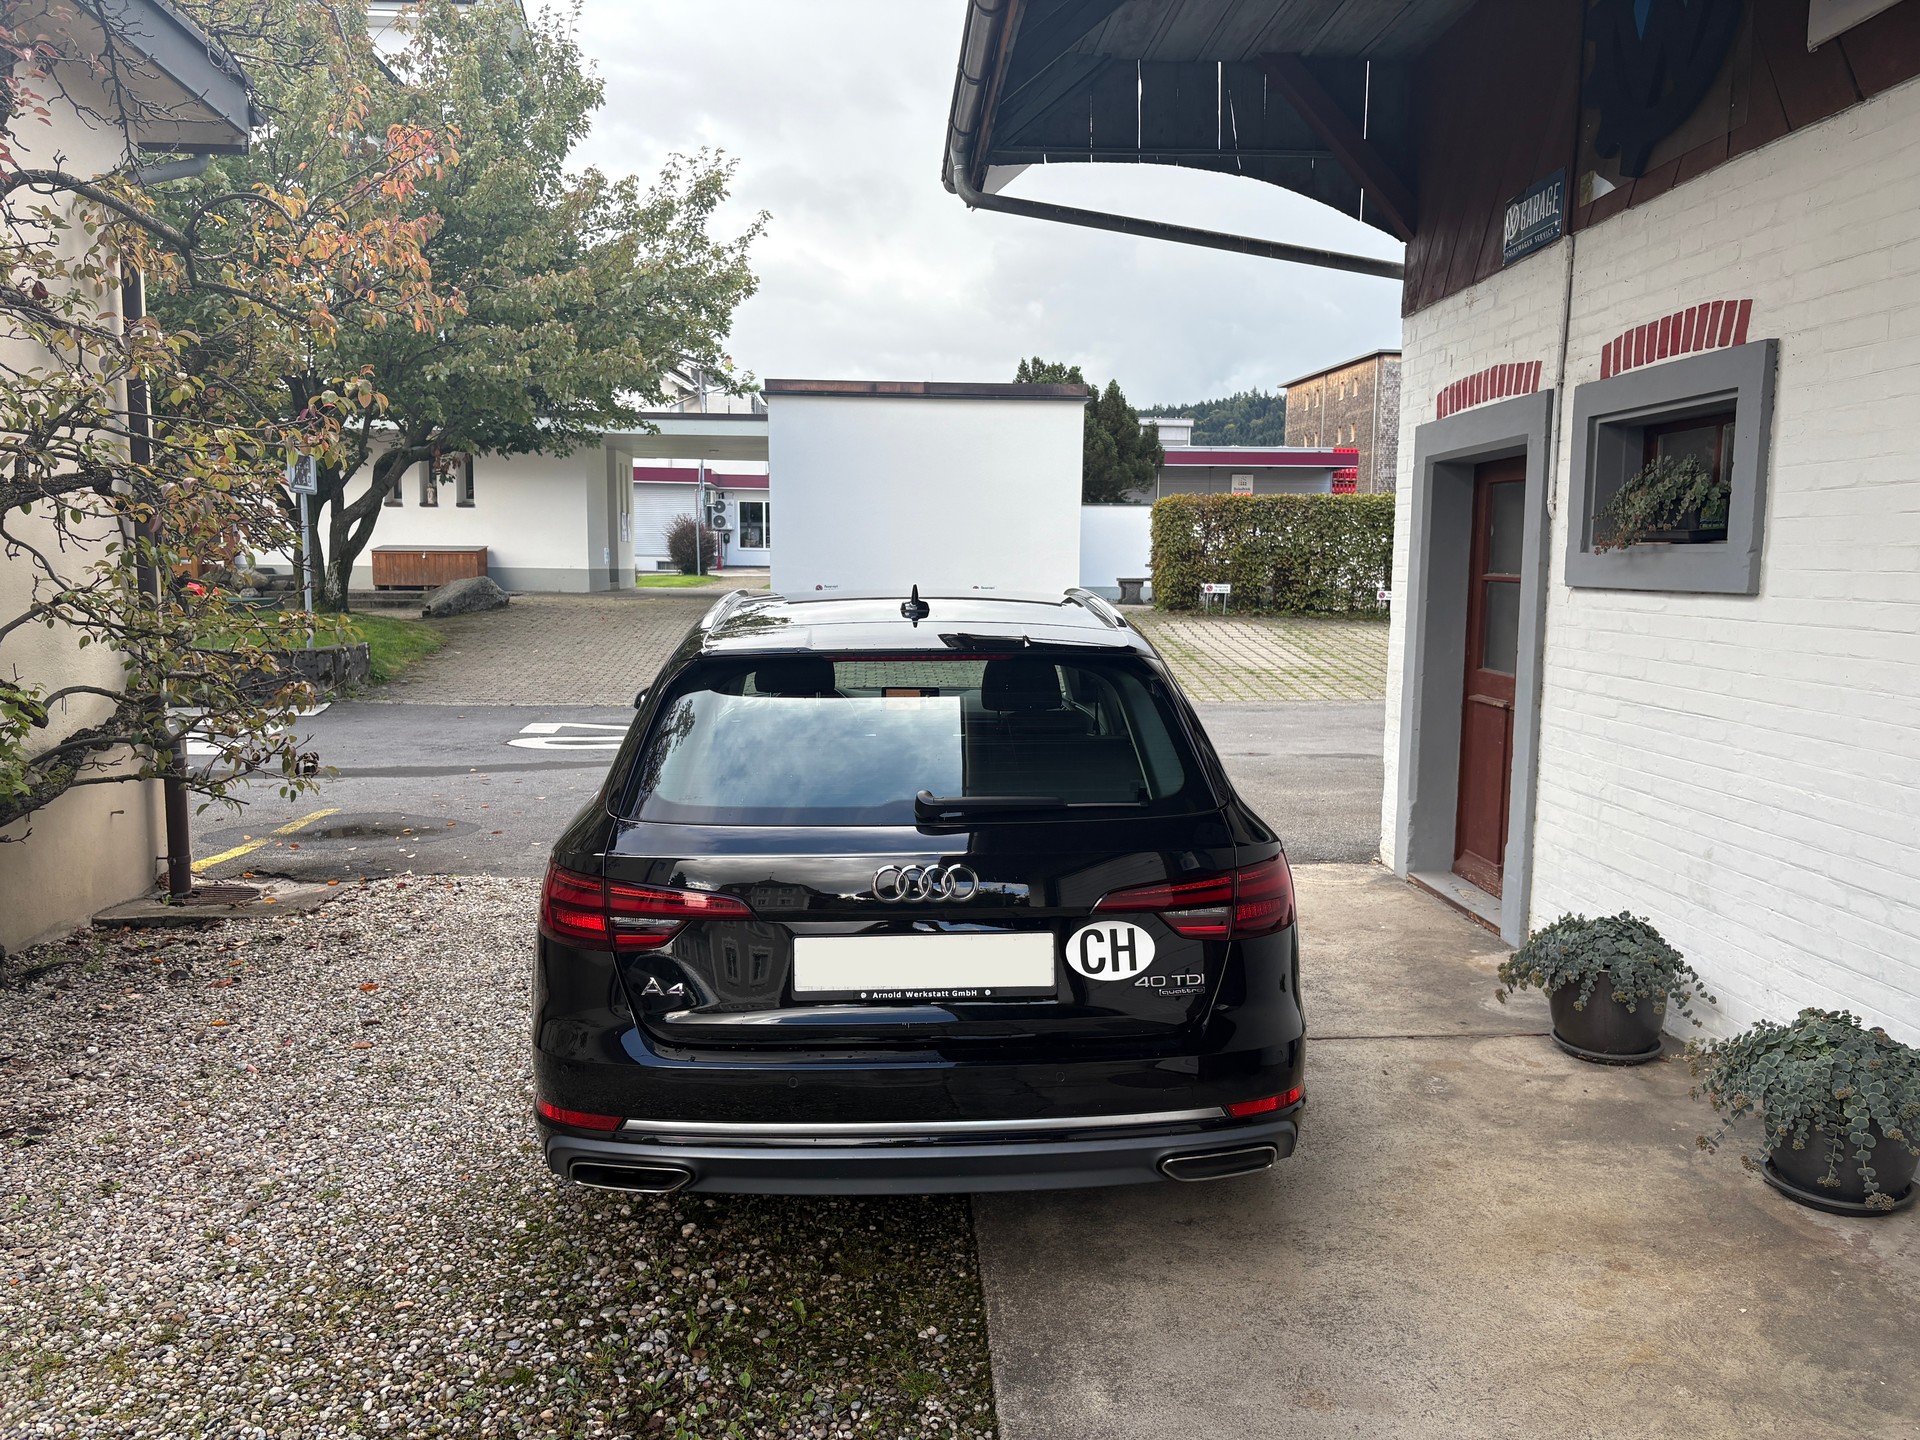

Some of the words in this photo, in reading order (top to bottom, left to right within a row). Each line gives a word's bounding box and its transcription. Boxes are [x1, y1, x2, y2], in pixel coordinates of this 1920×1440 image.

[1520, 182, 1560, 231] GARAGE
[1505, 239, 1533, 258] VOLKSWAGEN
[1534, 227, 1554, 243] SERVICE
[1079, 927, 1138, 975] CH
[641, 976, 685, 997] A4
[1134, 975, 1167, 988] 40
[1171, 973, 1206, 986] TDI
[1161, 986, 1204, 996] quattro
[872, 991, 902, 999] Arnold
[905, 990, 949, 998] Werkstatt
[951, 989, 978, 997] GmbH
